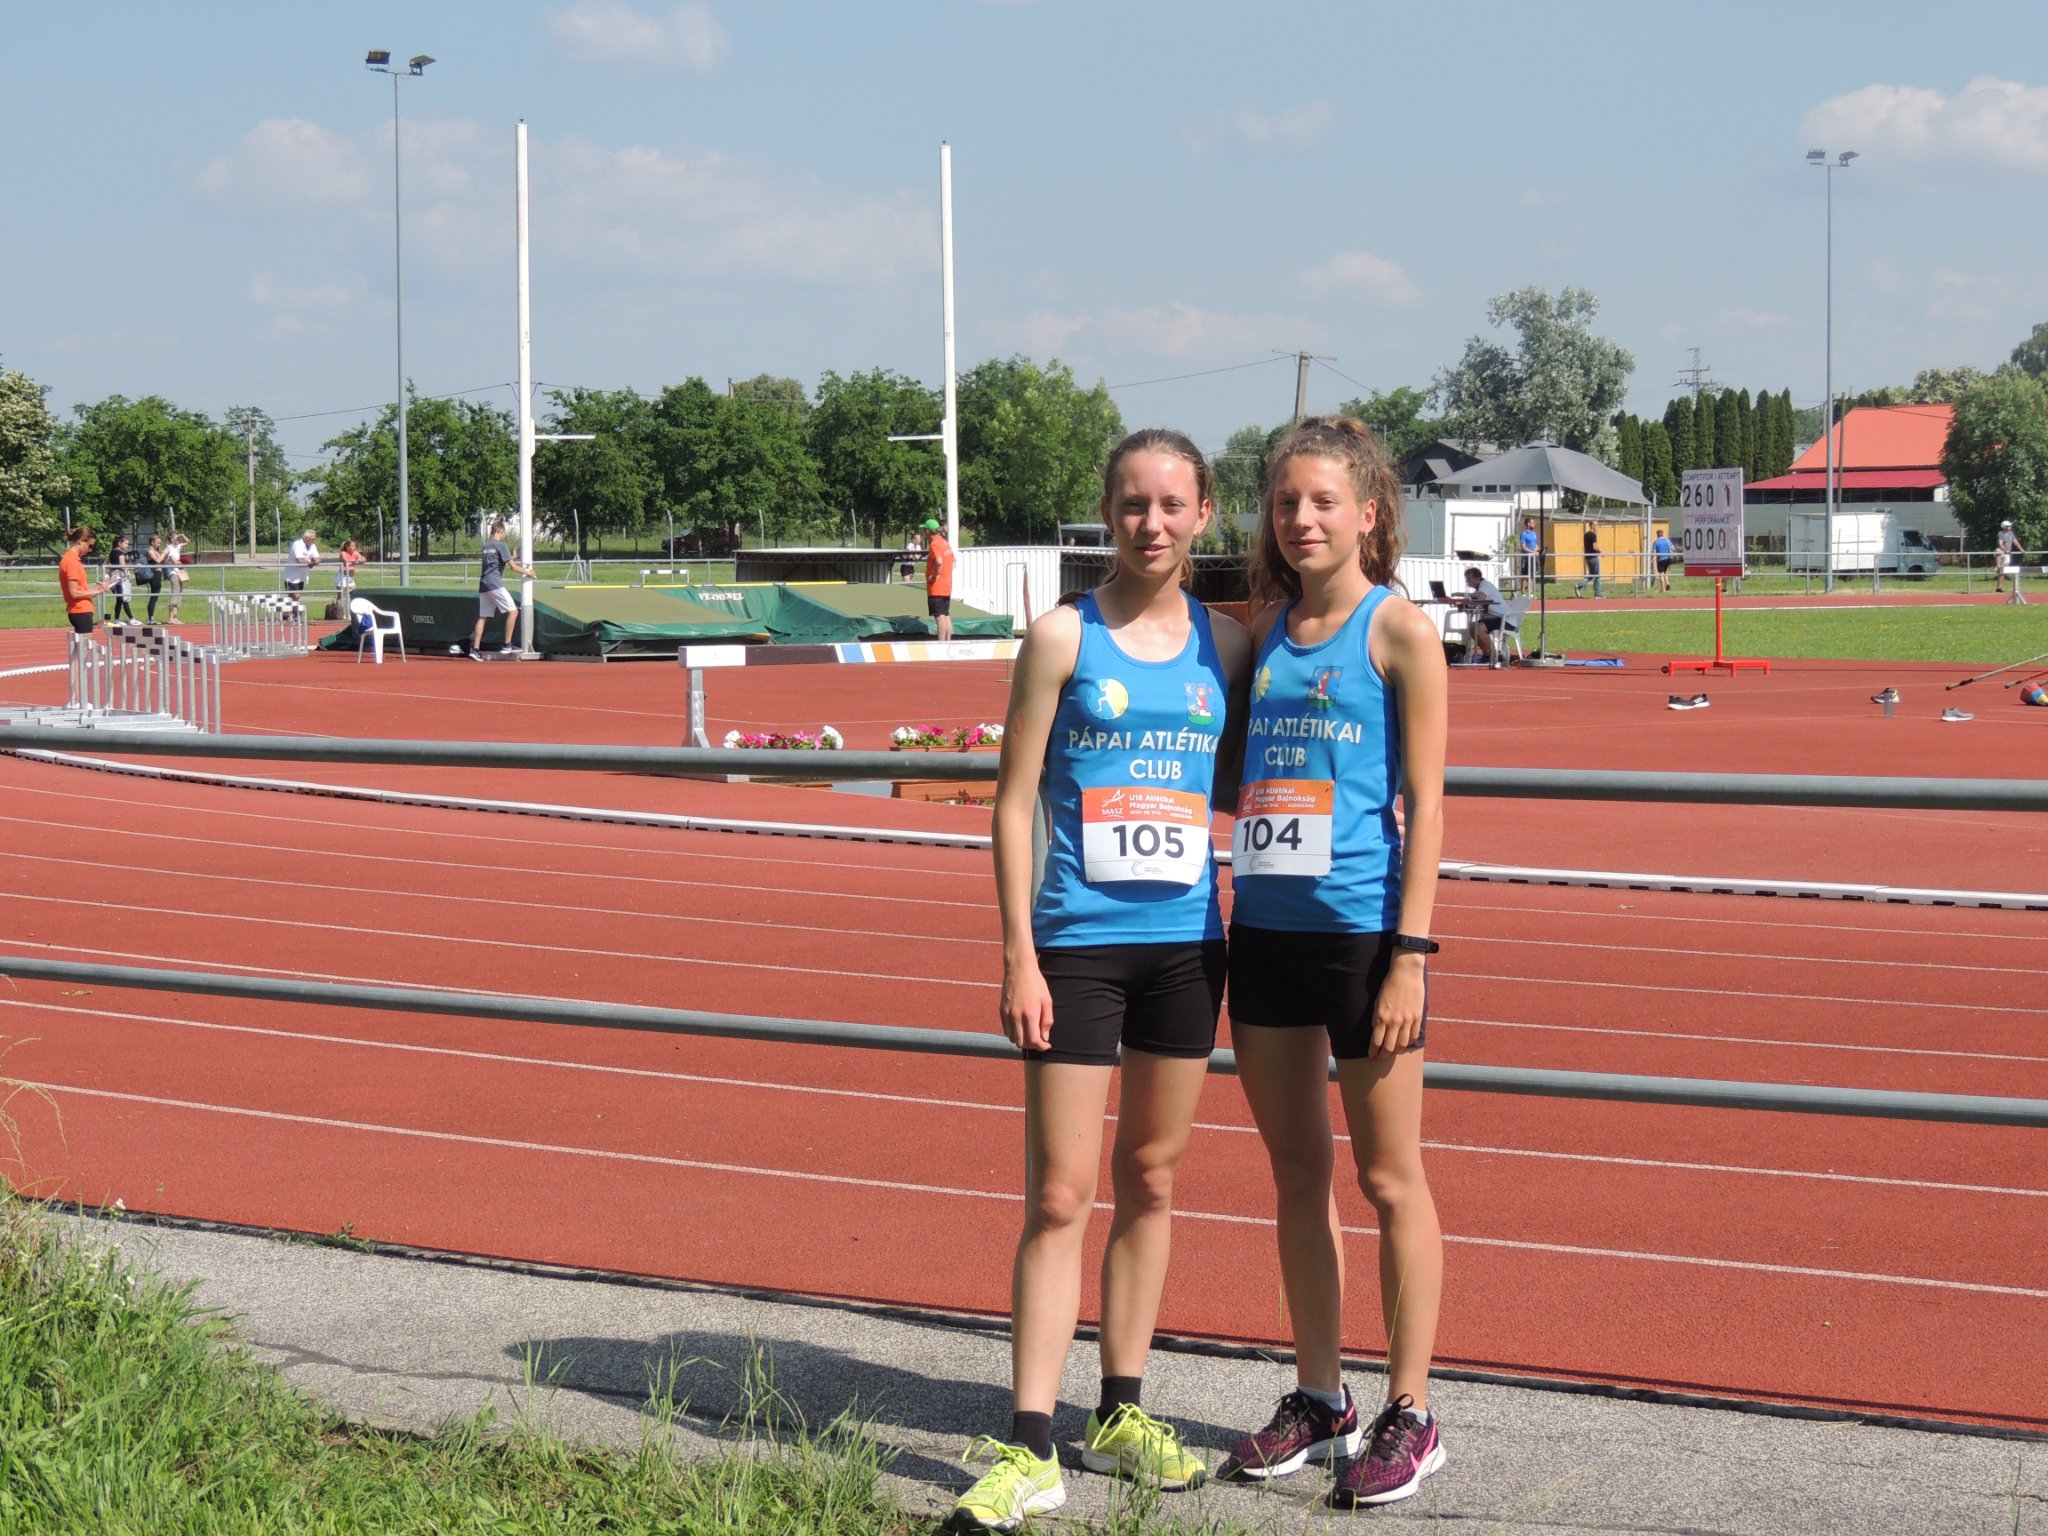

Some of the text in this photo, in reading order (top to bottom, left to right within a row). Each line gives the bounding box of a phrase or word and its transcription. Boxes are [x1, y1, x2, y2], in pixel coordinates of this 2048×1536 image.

[1684, 473, 1713, 481] COMPETITOR
[1718, 472, 1740, 480] ATTEMPT
[1683, 484, 1714, 508] 260
[1694, 516, 1730, 525] PERFORMANCE
[1068, 726, 1131, 750] PÁPAI
[1272, 712, 1362, 744] ATLÉTIKAI
[1264, 745, 1306, 767] CLUB
[1129, 758, 1182, 780] CLUB
[1129, 802, 1157, 810] Magyar
[1277, 794, 1316, 803] Bajnokság
[1112, 824, 1185, 859] 105
[1243, 817, 1302, 853] 104
